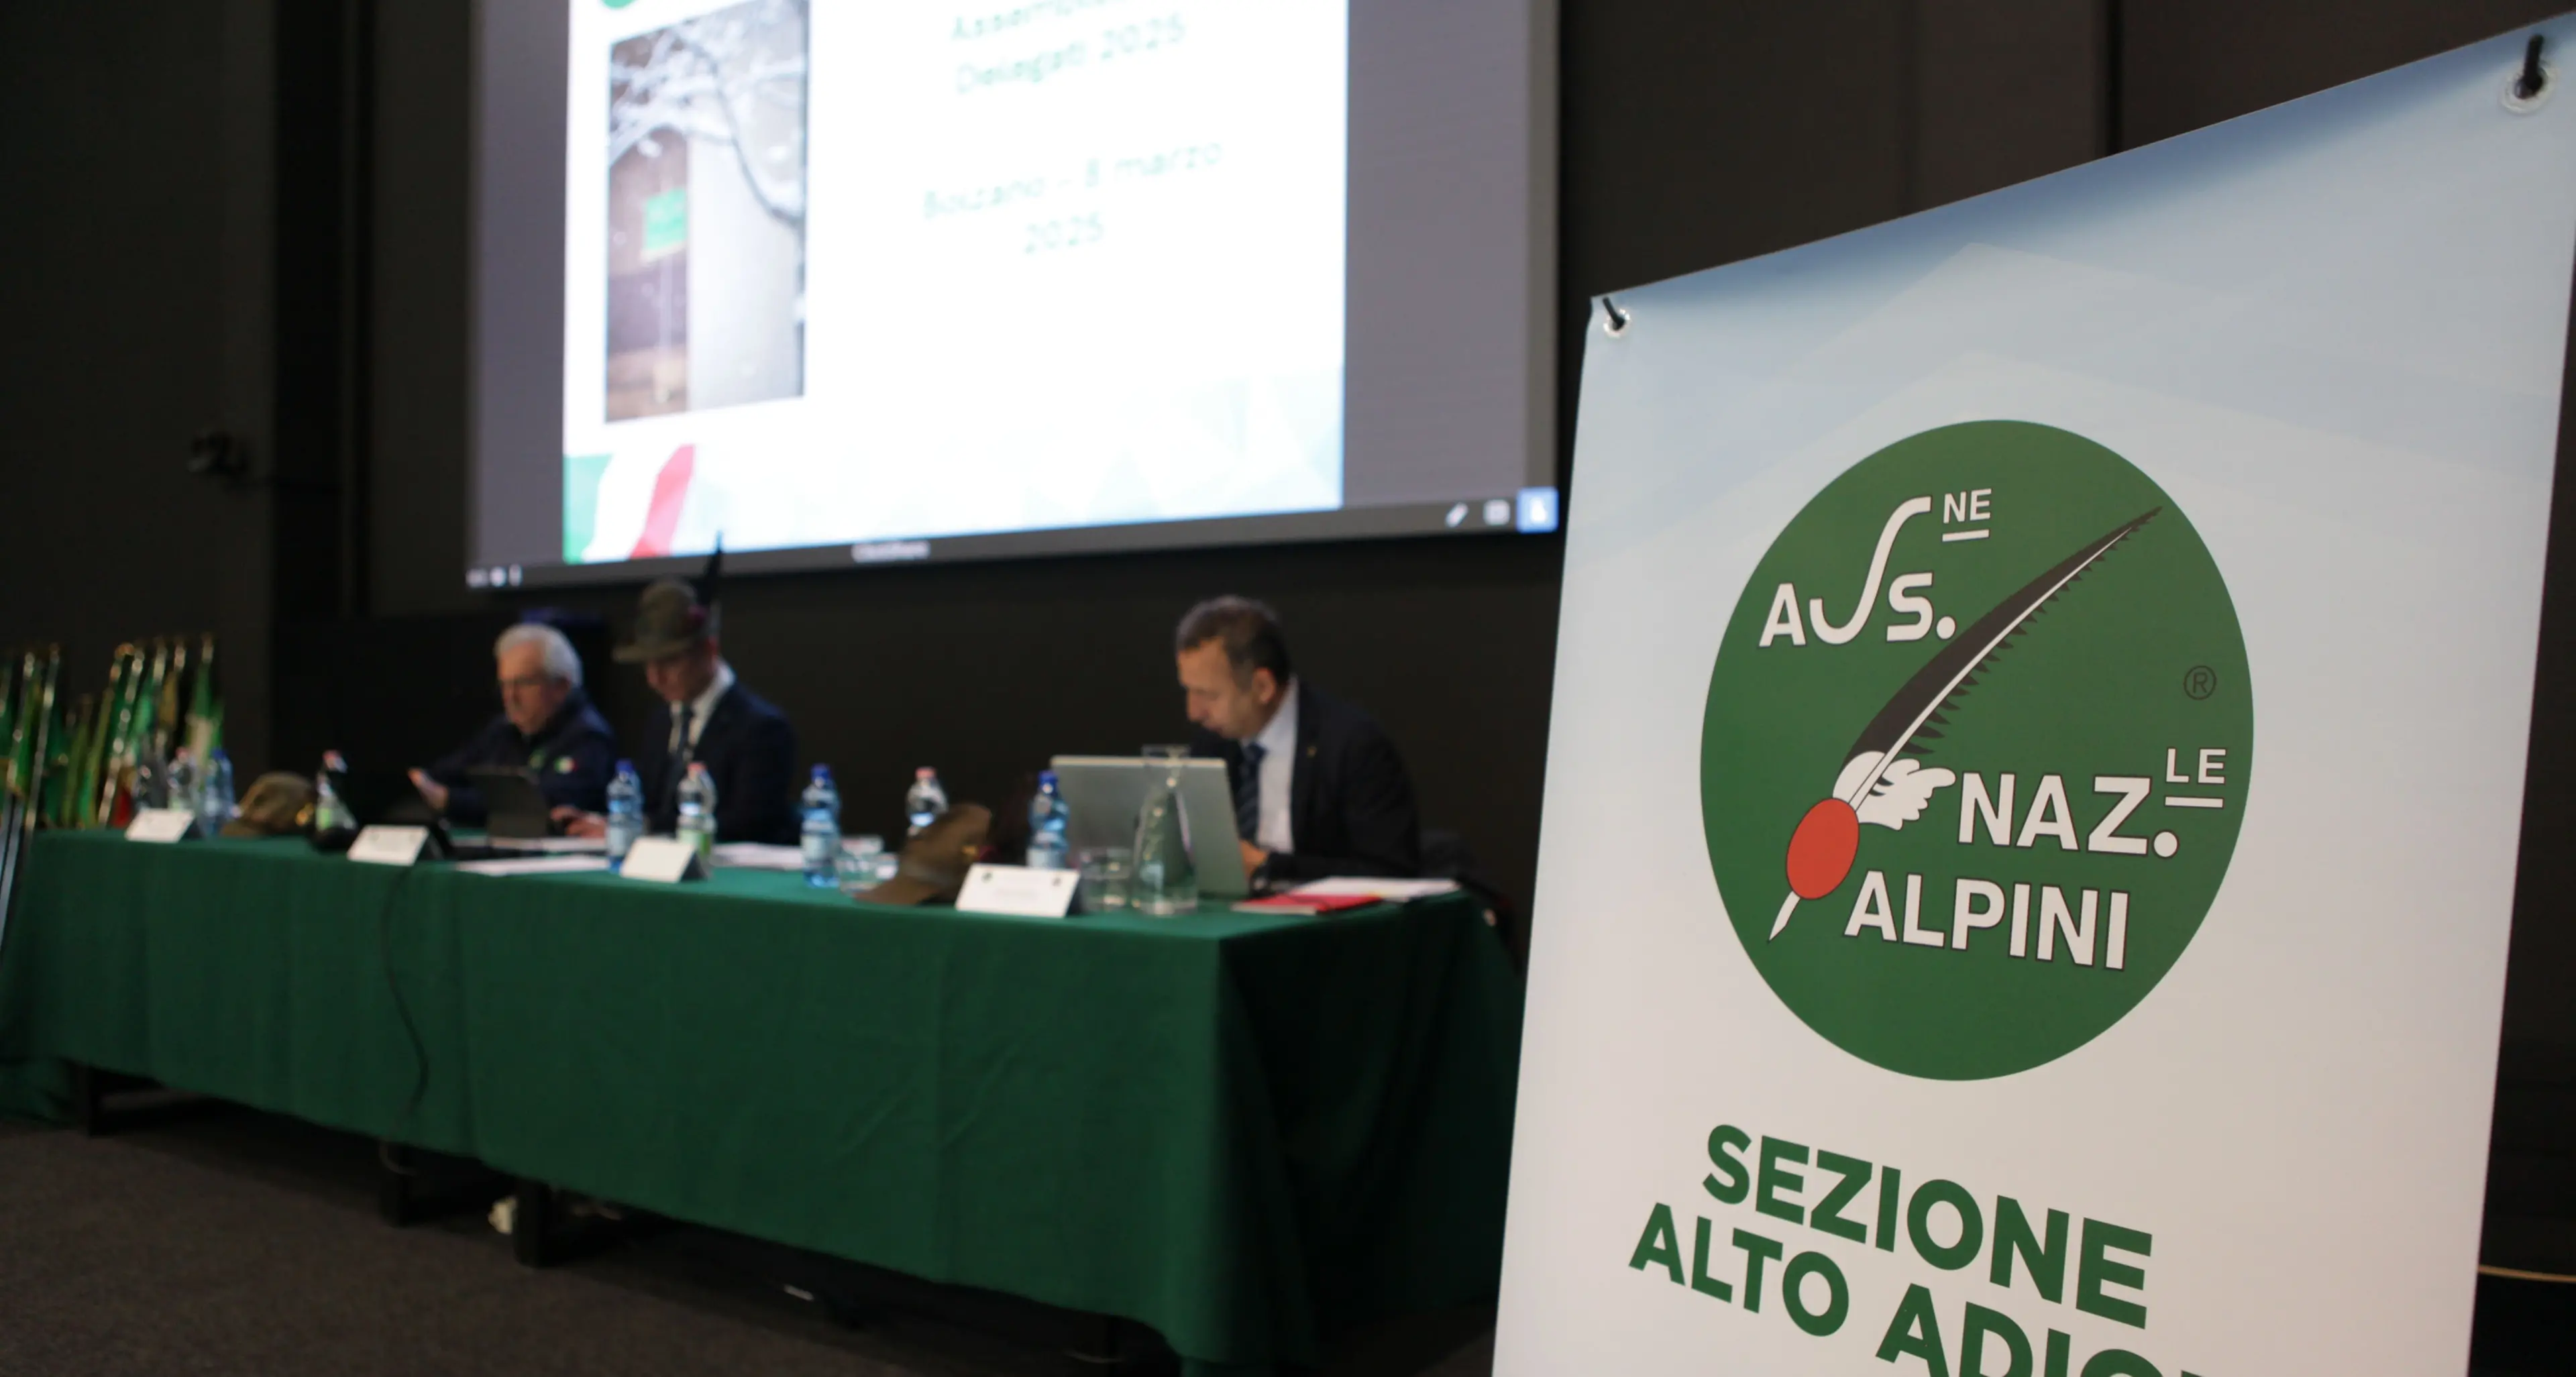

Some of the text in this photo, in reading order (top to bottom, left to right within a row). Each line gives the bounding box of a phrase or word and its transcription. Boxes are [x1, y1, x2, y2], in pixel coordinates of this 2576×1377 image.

[1100, 11, 1186, 60] 2025
[1114, 142, 1223, 176] marzo
[1024, 209, 1106, 255] 2025
[1843, 870, 2130, 971] ALPINI
[1702, 1124, 2153, 1329] SEZIONE
[1628, 1202, 2204, 1377] ALTO ADI
